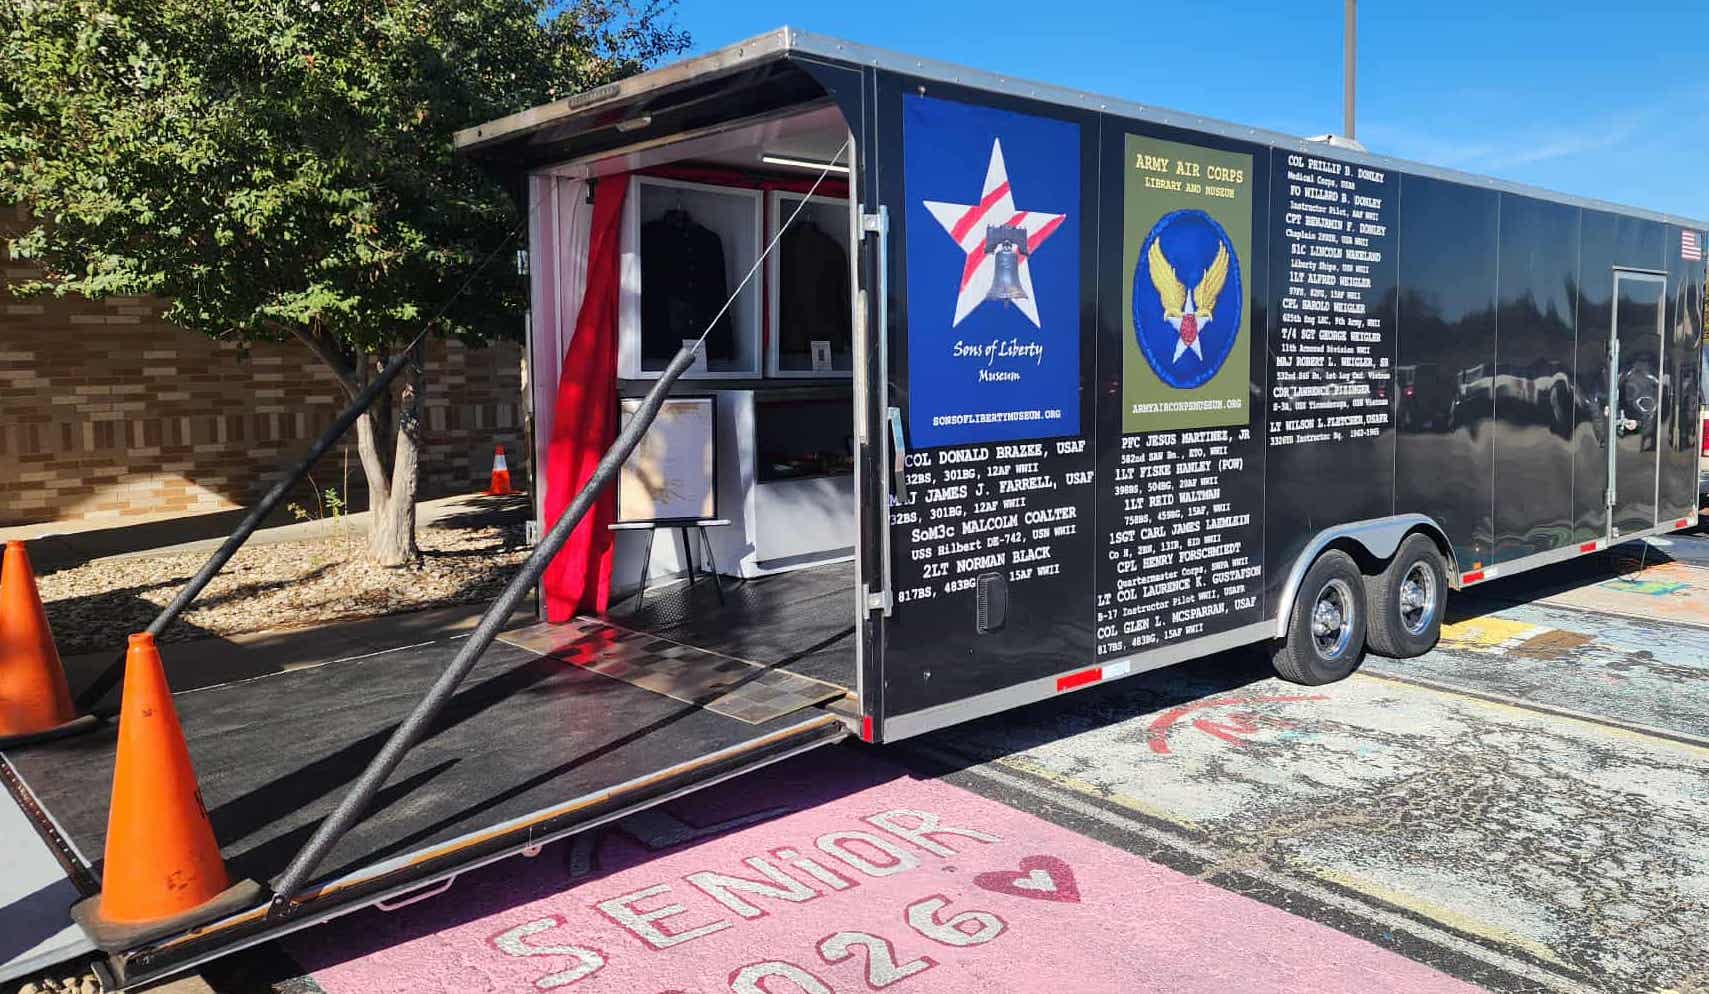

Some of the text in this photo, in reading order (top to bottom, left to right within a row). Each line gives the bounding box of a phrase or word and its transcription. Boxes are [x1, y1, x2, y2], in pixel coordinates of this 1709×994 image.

[1136, 154, 1243, 183] ARMY AIR CORPS
[1288, 155, 1304, 167] COL
[1308, 159, 1342, 176] PHILLIP
[1145, 177, 1182, 191] LIBRARY
[1186, 184, 1201, 195] AND
[953, 338, 1043, 366] Sons of Liberty
[1328, 357, 1337, 366] L.
[979, 369, 1020, 382] Museum
[933, 410, 1061, 426] SONSOFLIBERTYMUSEUM.ORG
[1122, 436, 1140, 449] PFC
[1146, 434, 1176, 446] JESUS
[1238, 429, 1250, 440] JR
[904, 440, 1086, 467] COL DONALD BRAZEE, USAF
[905, 463, 1039, 485] 32BS, 301BG, 12AF WWII
[1140, 465, 1171, 478] FISKE
[1176, 460, 1212, 474] HANLEY
[1218, 458, 1243, 472] (POW)
[889, 492, 917, 506] MJ
[925, 471, 1094, 503] JAMES J. FARRELL, USAF
[1124, 488, 1221, 510] 1LT REID WALTMAN
[890, 497, 1026, 526] 32BS, 301BG, 12AF WWII
[962, 515, 1018, 534] MALCOLM
[1025, 507, 1077, 524] COALTER
[912, 547, 932, 560] USS
[1054, 525, 1076, 536] WWII
[1109, 531, 1135, 544] 1SGT
[1141, 526, 1166, 540] CARL
[1172, 521, 1200, 535] JAMES
[923, 546, 1051, 579] 2LT NORMAN BLACK
[1109, 550, 1119, 560] Co
[1117, 560, 1137, 574] CPL
[1143, 554, 1174, 569] HENRY
[898, 586, 936, 602] 817BS,
[1009, 569, 1033, 581] 15AF
[1037, 564, 1060, 576] WWII
[1097, 593, 1112, 607] LT
[1117, 588, 1137, 602] COL
[1196, 576, 1206, 587] K.
[1212, 565, 1261, 584] GUSTAFSON
[1097, 597, 1257, 639] COL GLEN L. MCSPARRAN, USAF
[1098, 610, 1118, 622] B-17
[1123, 600, 1169, 617] Instructor
[1173, 596, 1195, 606] Pilot
[1097, 641, 1126, 655] 817BS,
[1164, 629, 1183, 639] 15AF
[1186, 623, 1204, 634] WWII
